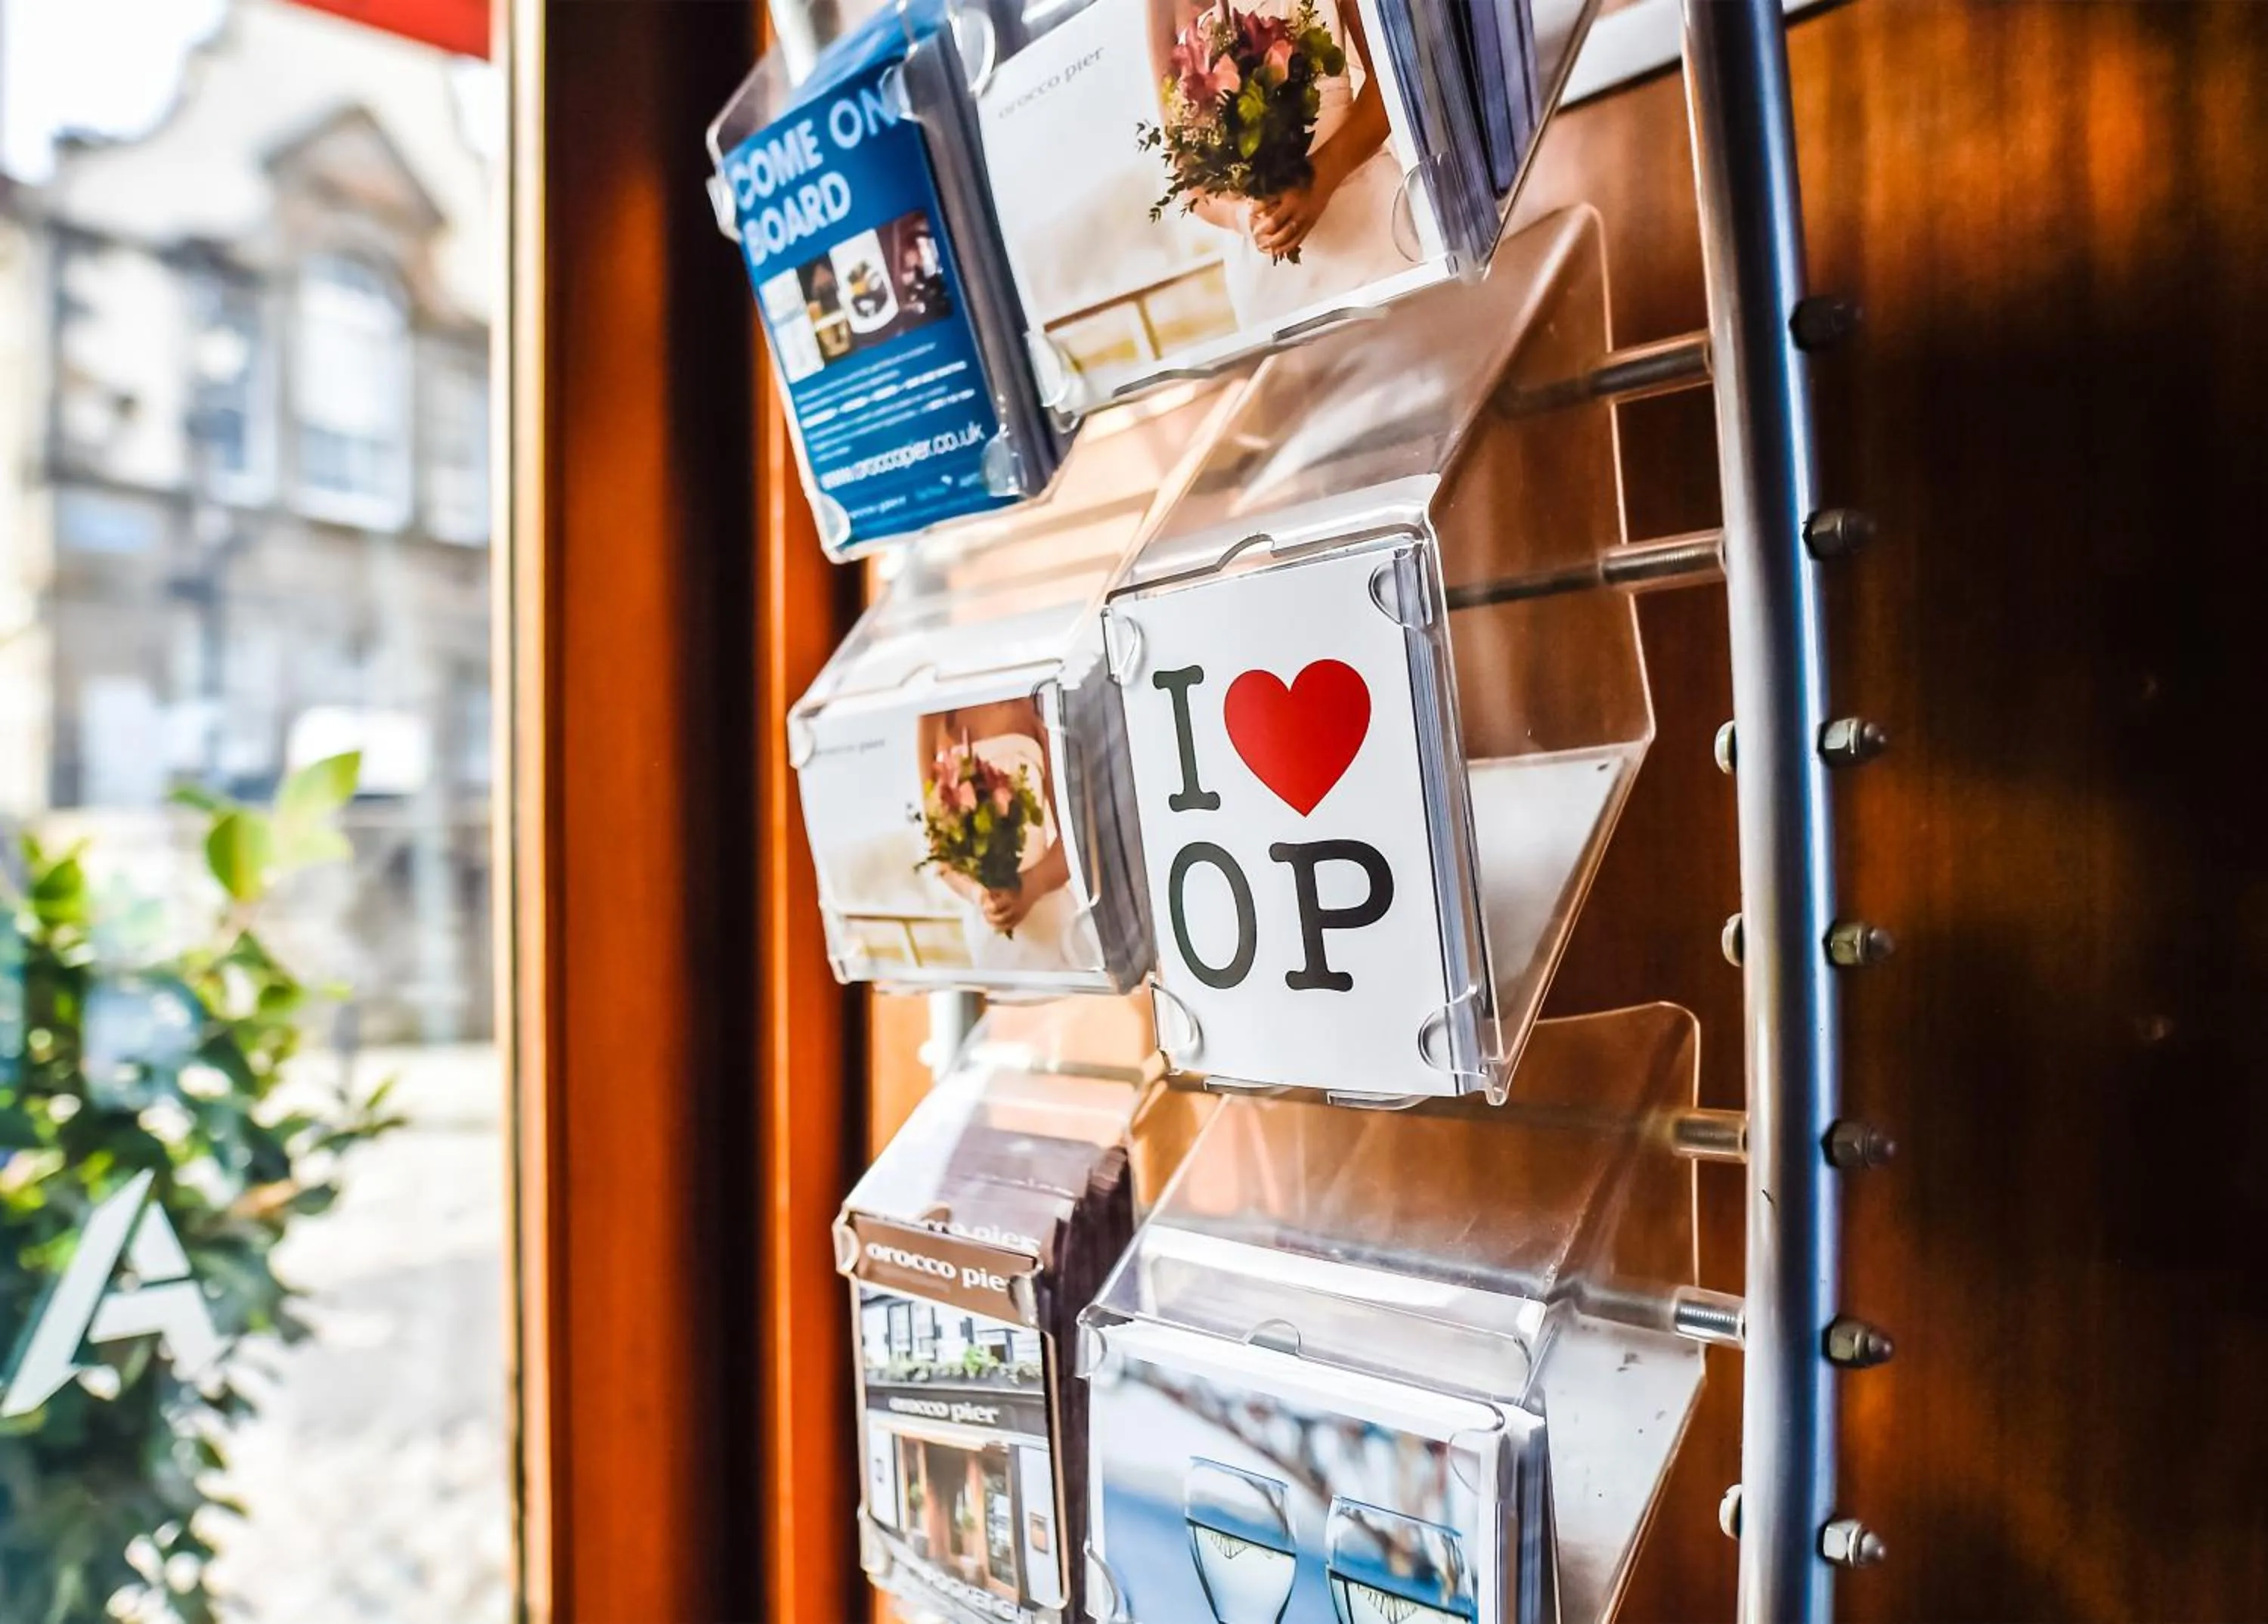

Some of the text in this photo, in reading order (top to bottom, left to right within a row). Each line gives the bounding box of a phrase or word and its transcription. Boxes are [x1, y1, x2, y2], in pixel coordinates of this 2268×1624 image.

[1064, 45, 1104, 83] pier
[729, 76, 906, 210] COME ON
[742, 171, 852, 266] BOARD
[1152, 665, 1220, 812] I
[1168, 839, 1394, 992] OP
[866, 1242, 1009, 1292] orocco pie
[950, 1402, 1000, 1424] pier
